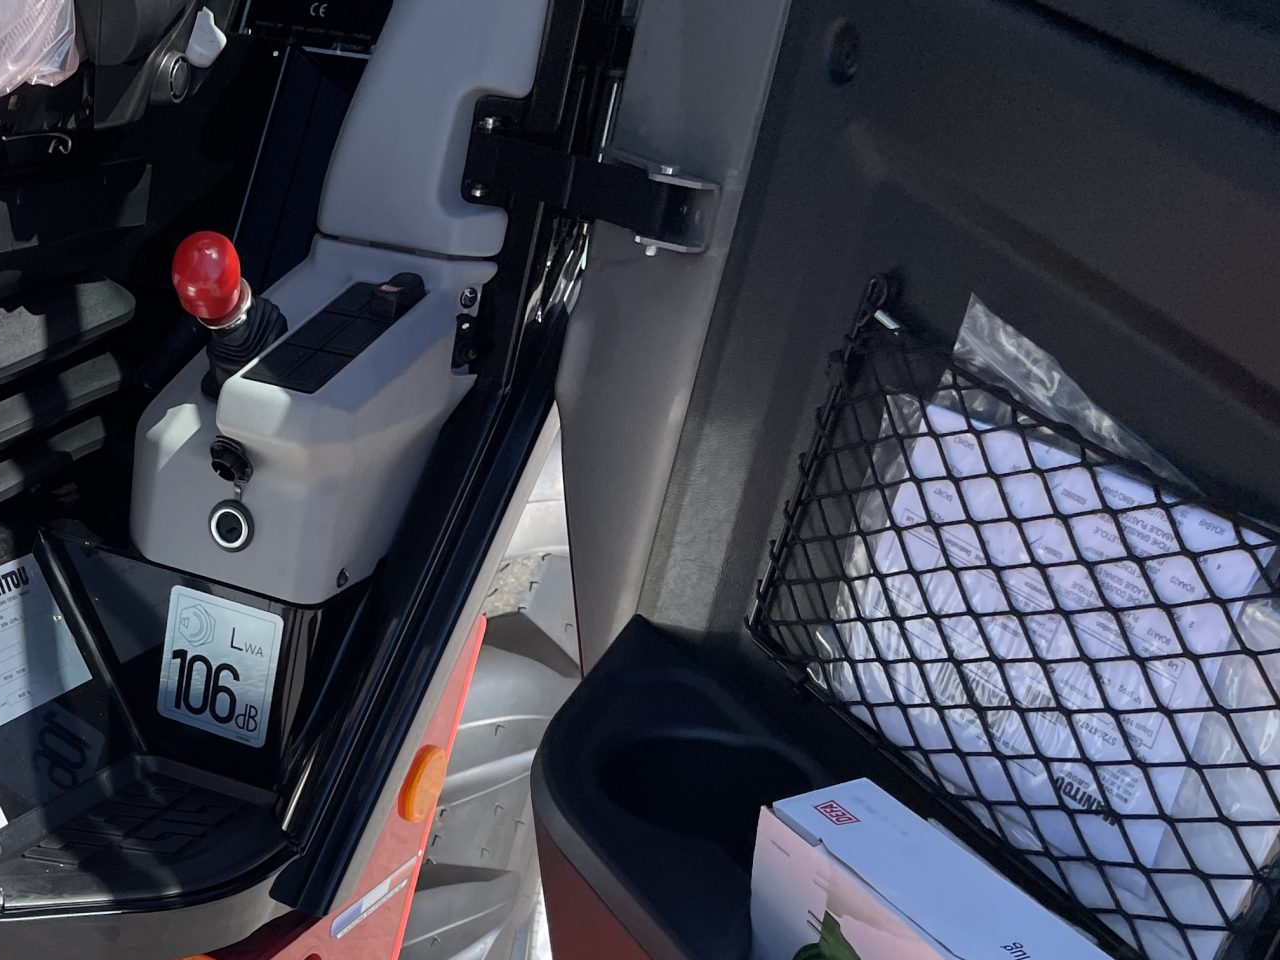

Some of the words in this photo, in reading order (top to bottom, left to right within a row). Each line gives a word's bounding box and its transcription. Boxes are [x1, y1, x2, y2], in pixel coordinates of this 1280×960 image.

[171, 649, 241, 725] 106
[235, 704, 259, 733] dB
[820, 802, 852, 824] DEFA
